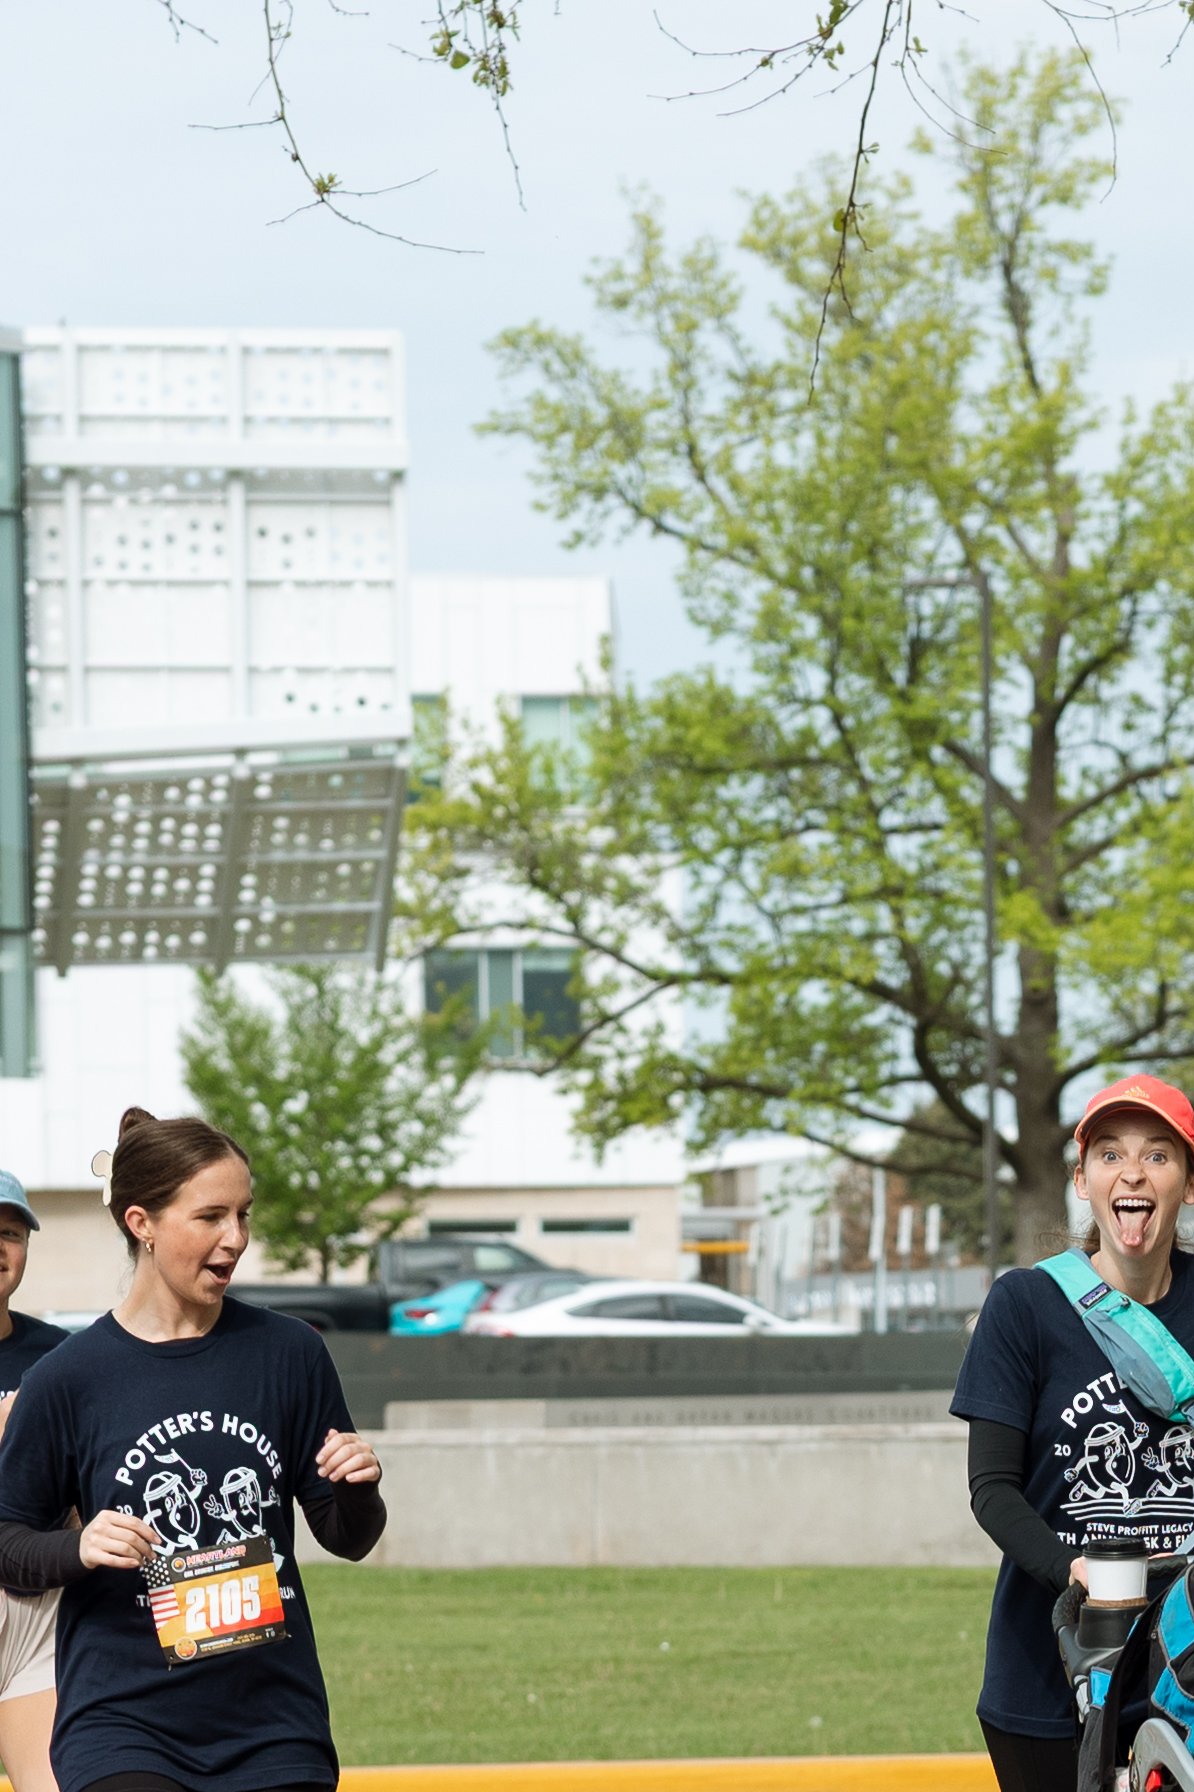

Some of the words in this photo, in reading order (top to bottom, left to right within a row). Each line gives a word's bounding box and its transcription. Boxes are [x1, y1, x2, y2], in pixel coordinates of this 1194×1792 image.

[1060, 1371, 1129, 1429] POTT
[115, 1410, 214, 1486] POTTER'S
[221, 1413, 283, 1480] HOUSE
[1054, 1444, 1071, 1457] 20
[1086, 1522, 1115, 1533] STEVE
[1117, 1525, 1159, 1536] PROFFITT
[1161, 1522, 1193, 1533] LEGACY
[1163, 1537, 1172, 1549] &
[185, 1576, 261, 1633] 2105
